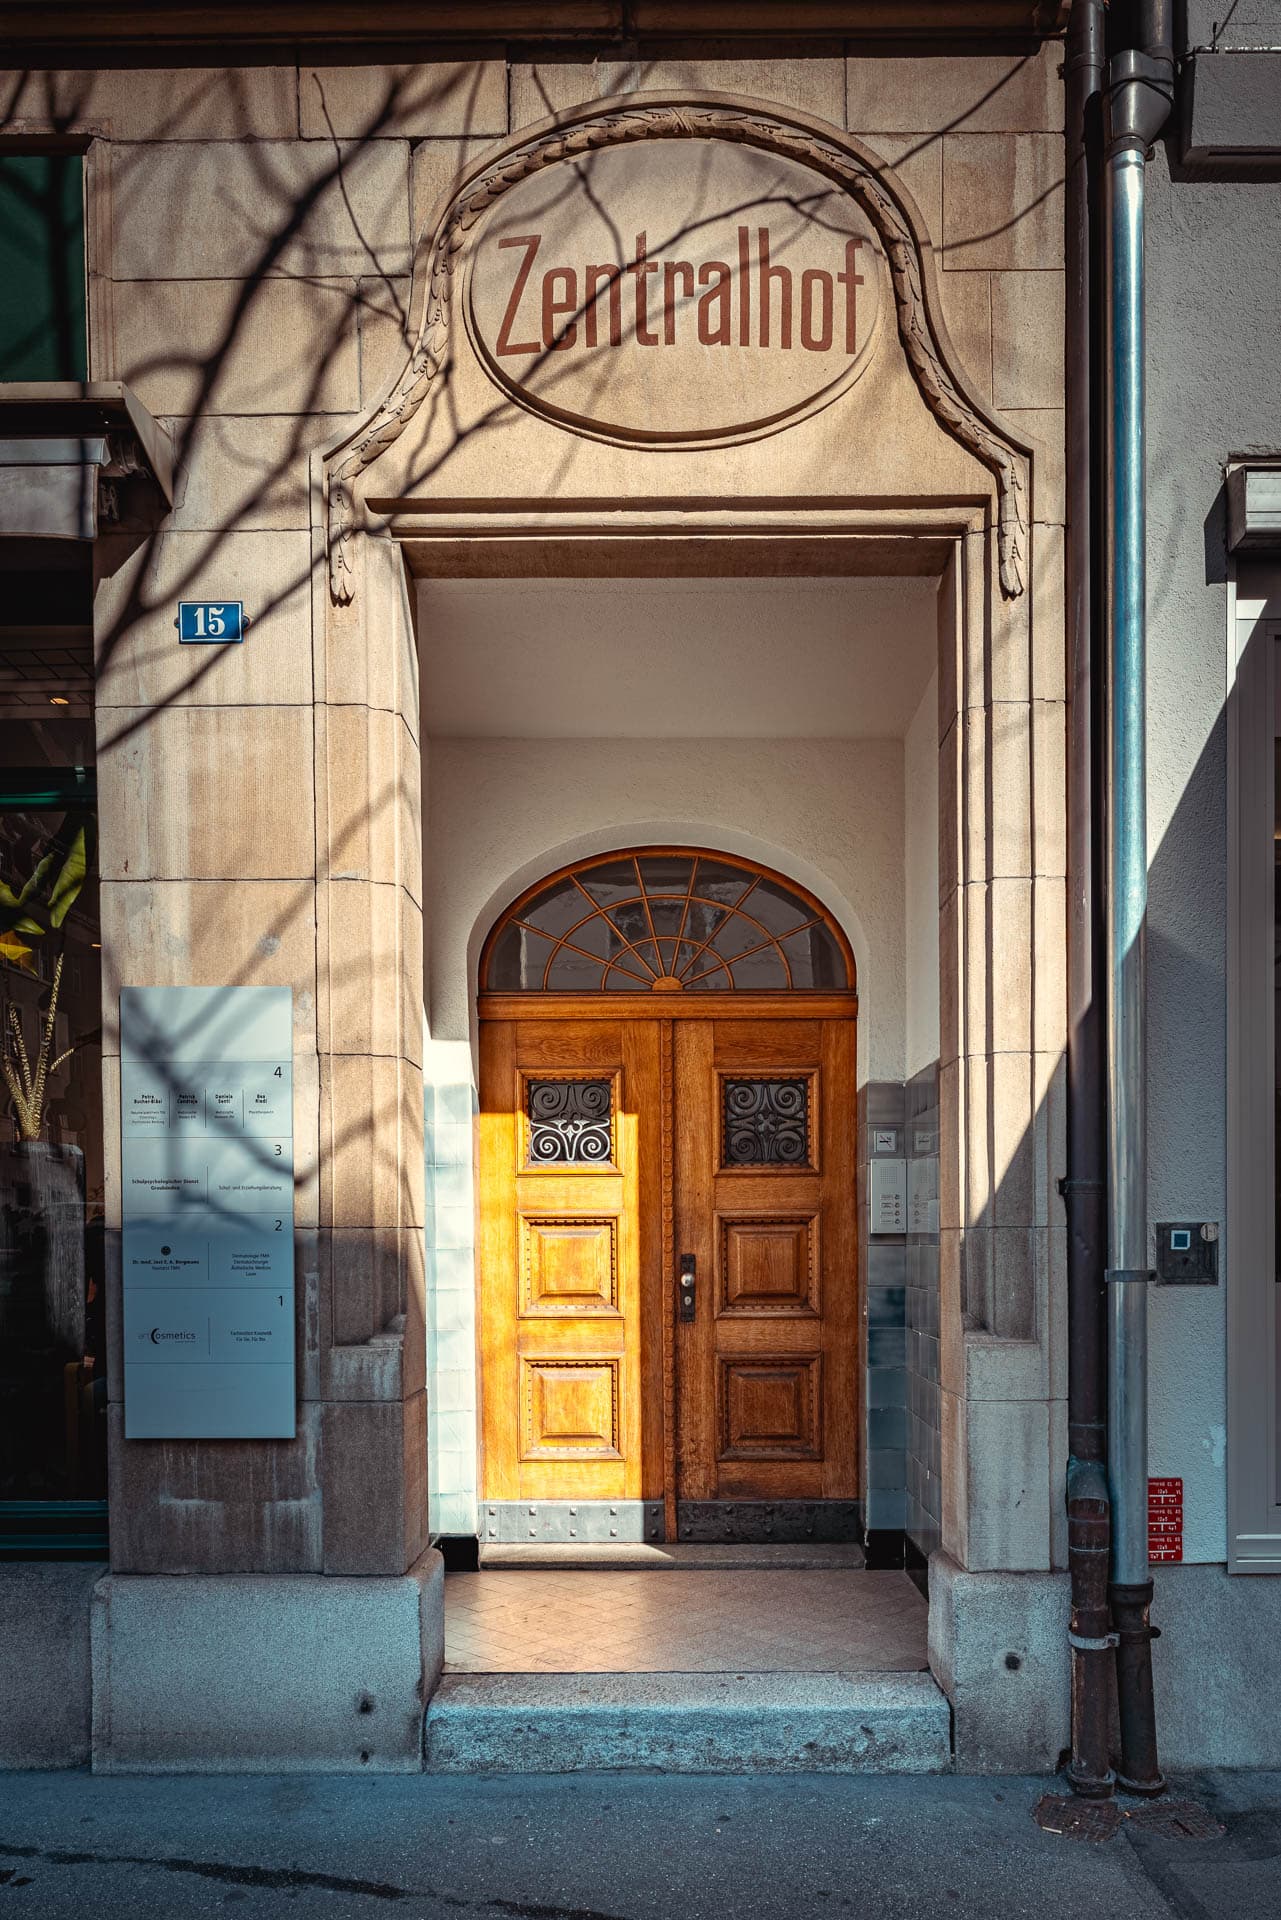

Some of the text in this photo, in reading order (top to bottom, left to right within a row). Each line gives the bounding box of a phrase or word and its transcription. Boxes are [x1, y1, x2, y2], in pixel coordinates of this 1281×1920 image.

[496, 226, 865, 356] Zentralhof
[194, 607, 225, 636] 15
[273, 1066, 283, 1078] 4
[274, 1144, 282, 1156] 3
[275, 1219, 283, 1232] 2
[277, 1295, 284, 1307] 1
